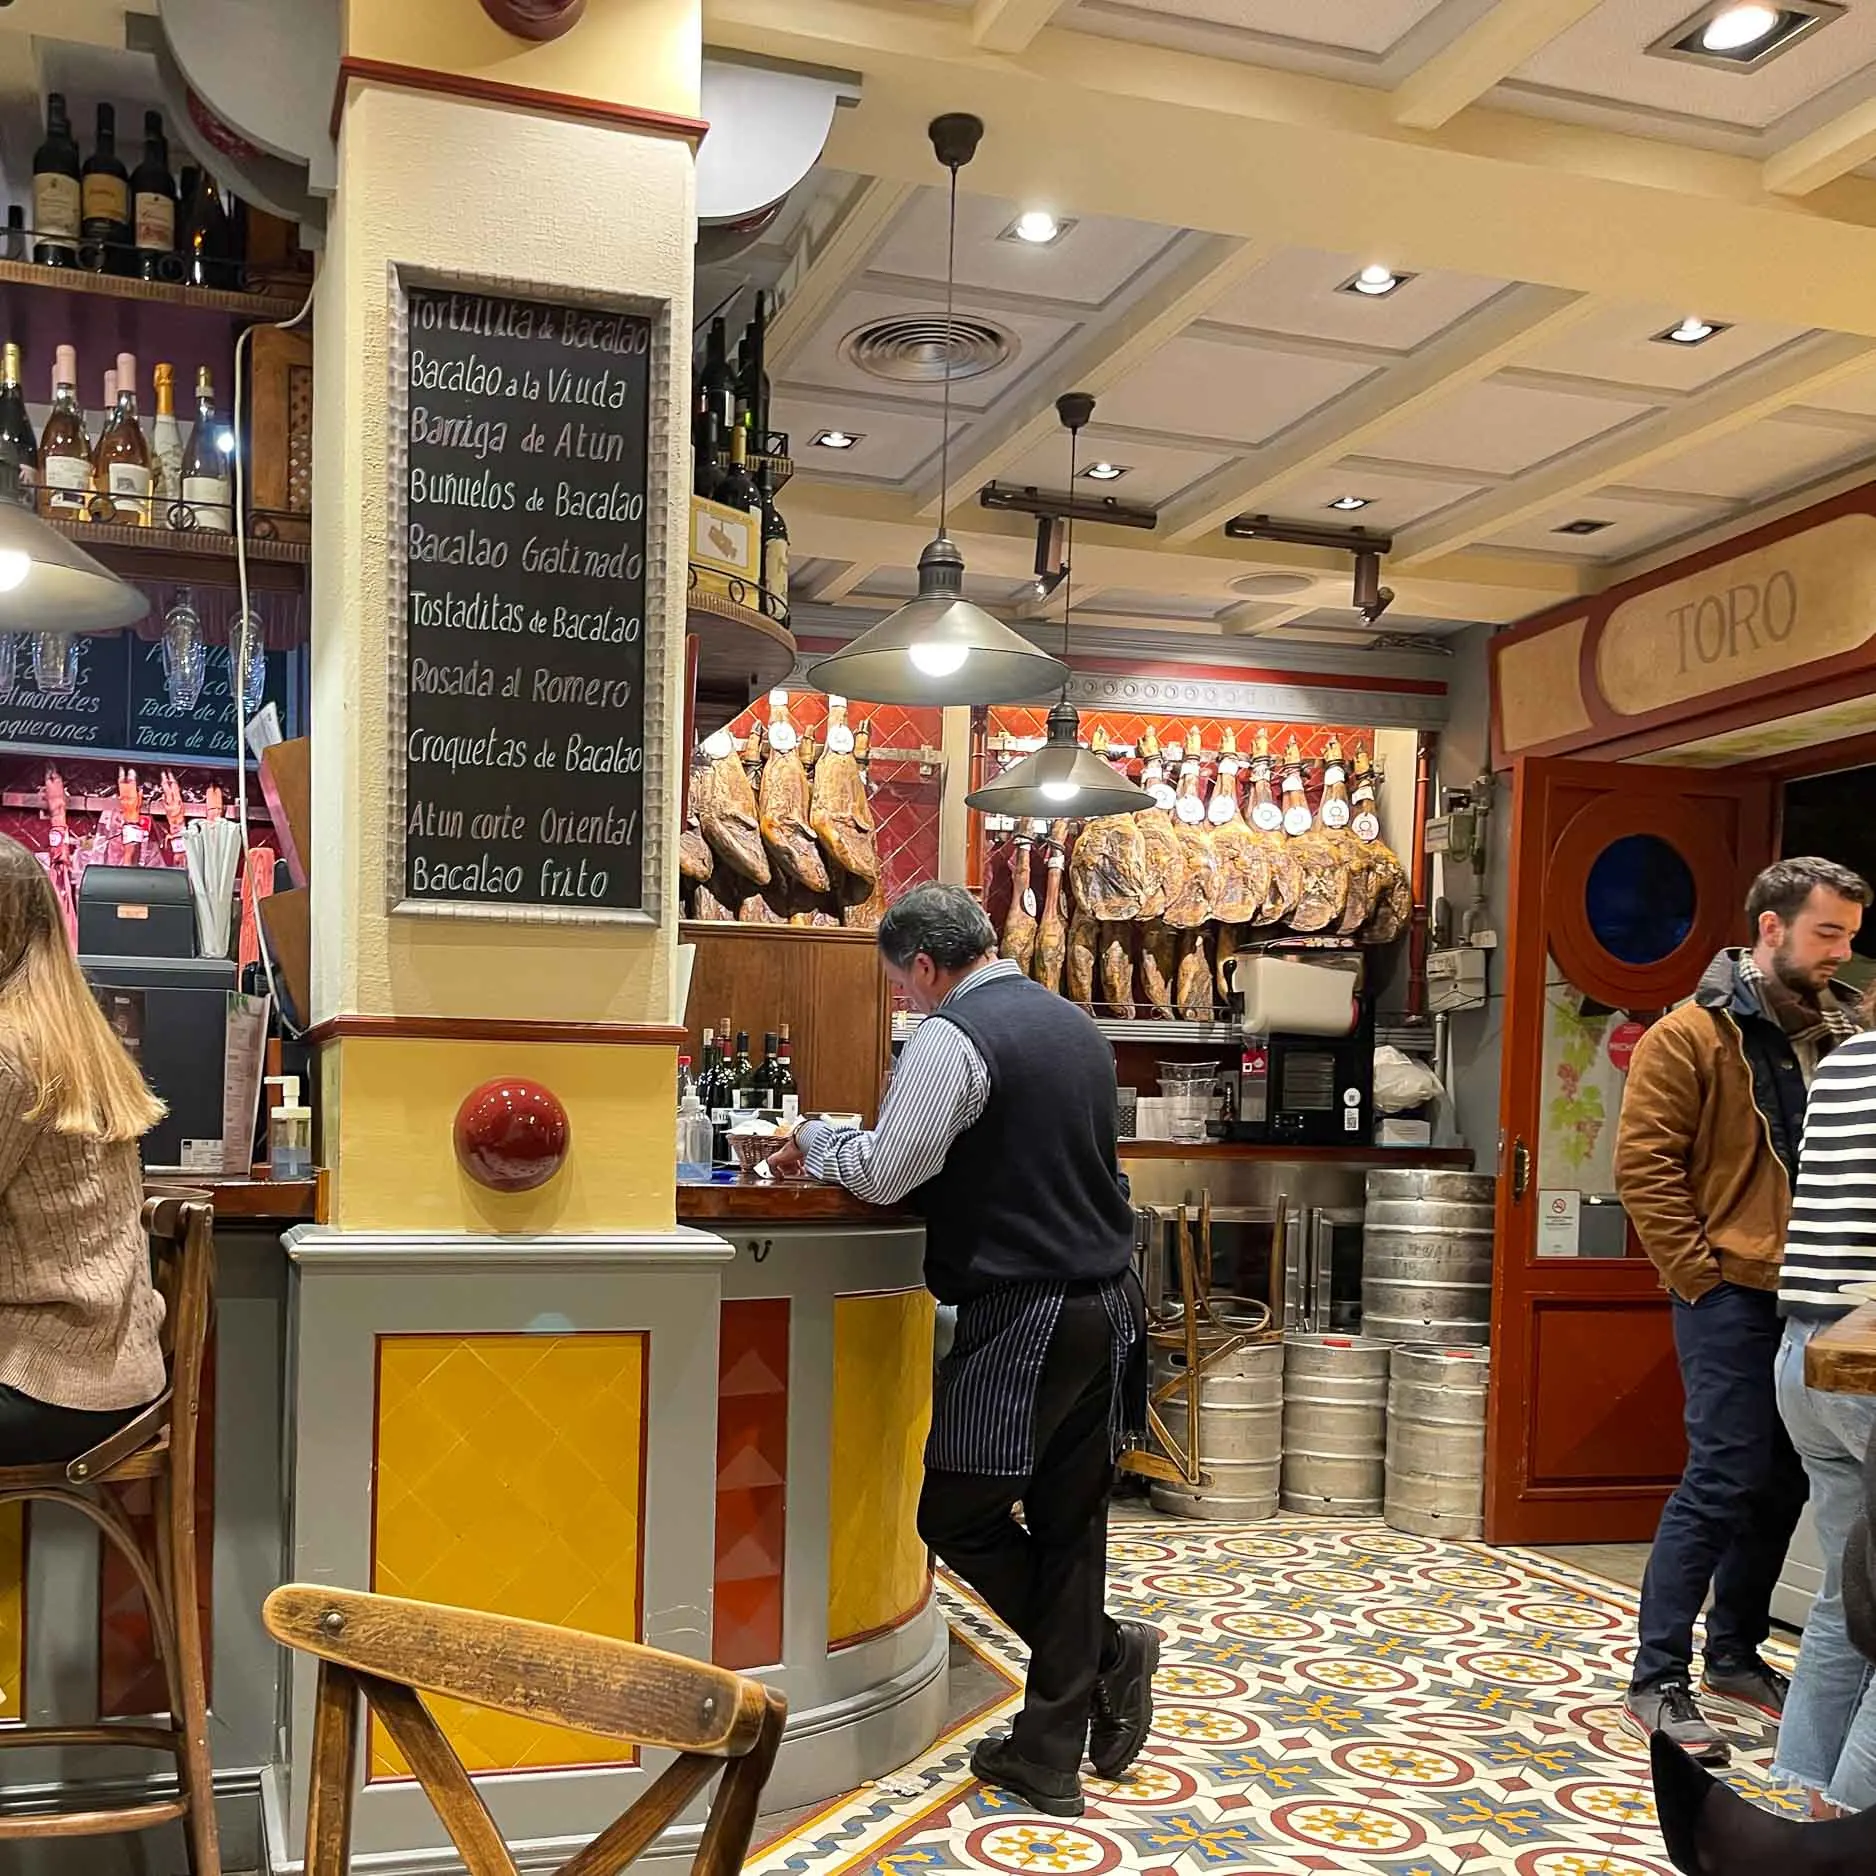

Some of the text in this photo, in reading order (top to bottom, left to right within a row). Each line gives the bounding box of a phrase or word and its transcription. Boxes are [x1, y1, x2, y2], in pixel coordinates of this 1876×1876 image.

[538, 312, 554, 340] de
[561, 310, 650, 355] Bacalao
[411, 350, 628, 408] Bacalao a la Viuda
[411, 406, 508, 460] Barriga
[520, 423, 545, 454] de
[410, 468, 644, 521] Buñuelos de Bacalao
[409, 523, 644, 580] Bacalao Gratinado
[410, 592, 640, 644] Tostaditas de Bacalao
[1666, 570, 1798, 676] TORO
[411, 657, 631, 708] Rosada al Romero
[136, 726, 179, 748] Tacos
[185, 728, 205, 749] de
[193, 704, 216, 721] de
[408, 728, 643, 774] Croquetas de Bacalao
[408, 800, 638, 846] Atun corte Oriental
[413, 854, 523, 893] Bacalao
